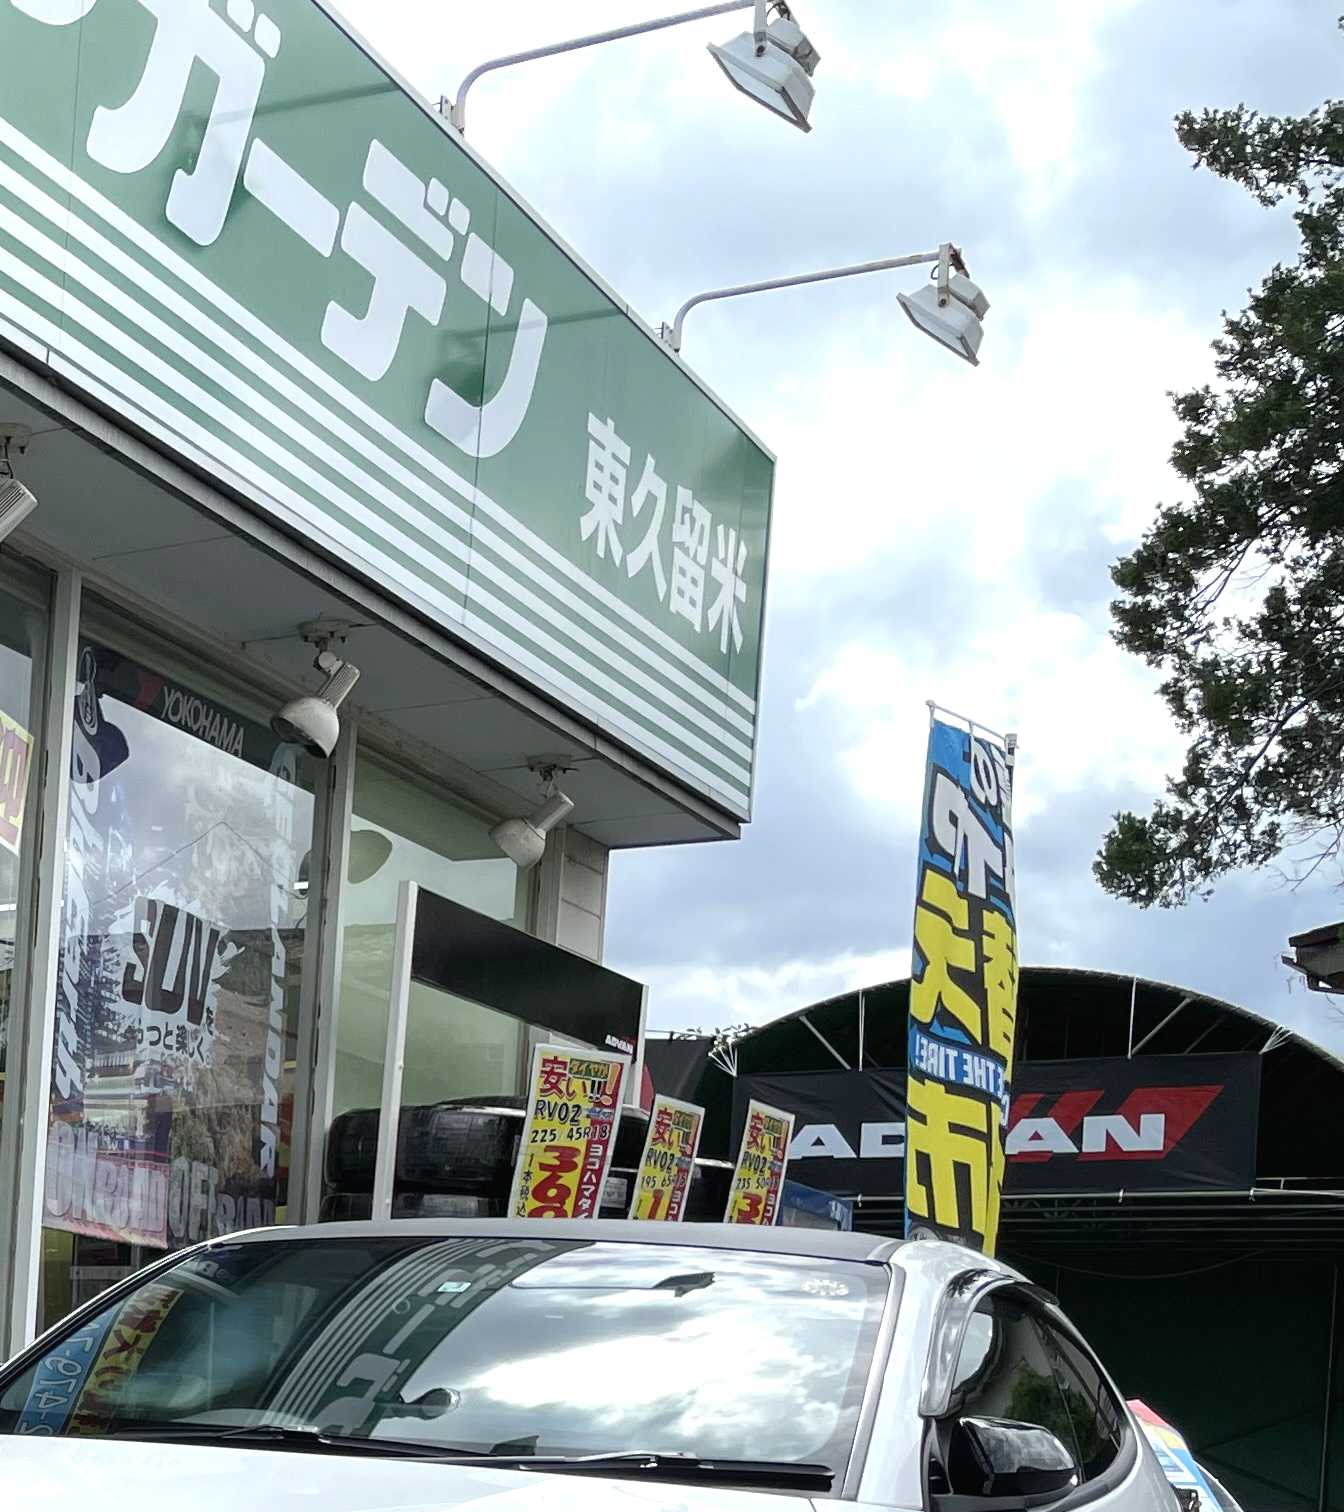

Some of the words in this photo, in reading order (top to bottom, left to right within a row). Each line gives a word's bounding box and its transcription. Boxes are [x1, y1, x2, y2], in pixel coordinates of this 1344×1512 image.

[579, 415, 748, 657] 東久留米
[161, 684, 246, 758] YOKOHAMA
[122, 897, 221, 1026] SUV
[535, 1099, 583, 1126] RV02
[789, 1112, 1166, 1160] ADAN
